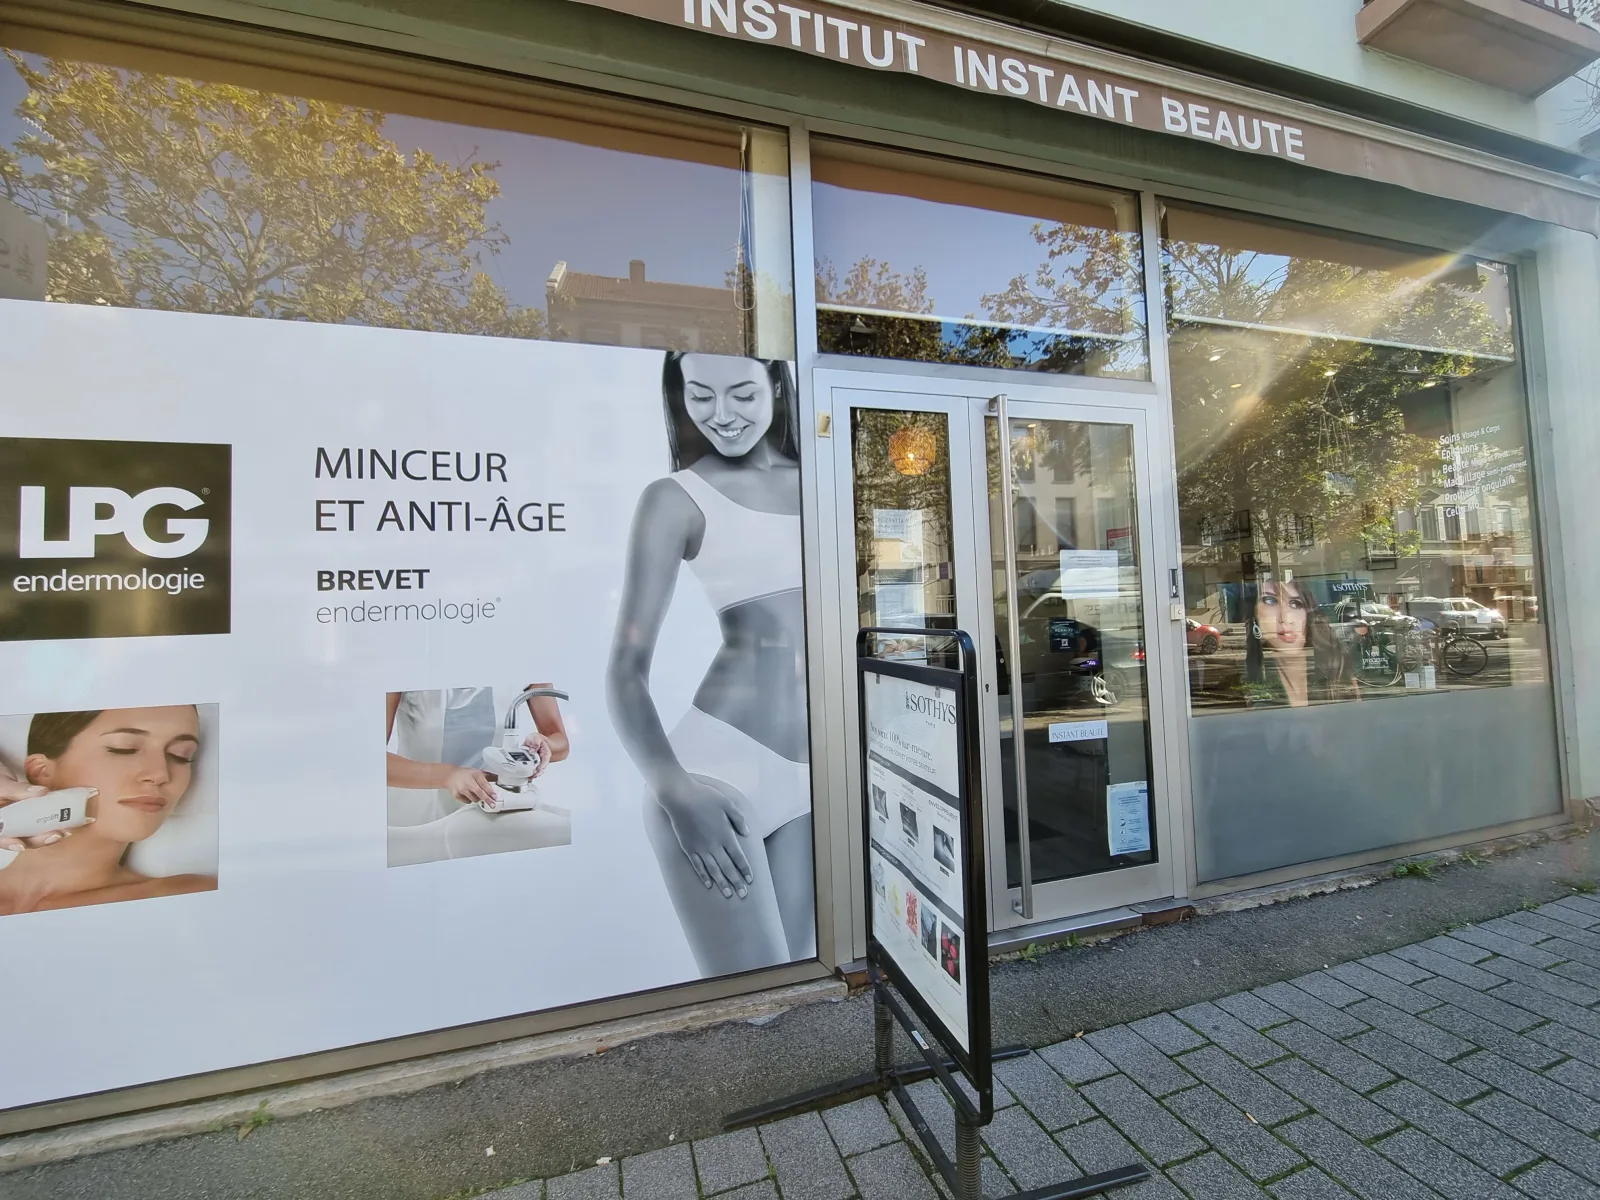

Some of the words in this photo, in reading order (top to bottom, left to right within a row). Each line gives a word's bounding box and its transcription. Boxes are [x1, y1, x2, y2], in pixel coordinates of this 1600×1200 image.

[684, 0, 926, 74] INSTITUT
[954, 45, 1139, 123] INSTANT
[1162, 96, 1306, 161] BEAUTE
[1439, 433, 1460, 445] Soins
[1461, 430, 1480, 439] Visage
[1480, 427, 1485, 435] &
[313, 447, 508, 483] MINCEUR
[1443, 470, 1486, 488] Maquillage
[314, 499, 365, 532] ET
[376, 495, 567, 533] ANTI-ÂGE
[13, 567, 205, 595] endermologie
[316, 569, 430, 592] BREVET
[1337, 583, 1368, 592] SOTHYS
[910, 693, 956, 725] SOTHYS
[1052, 730, 1079, 740] INSTANT
